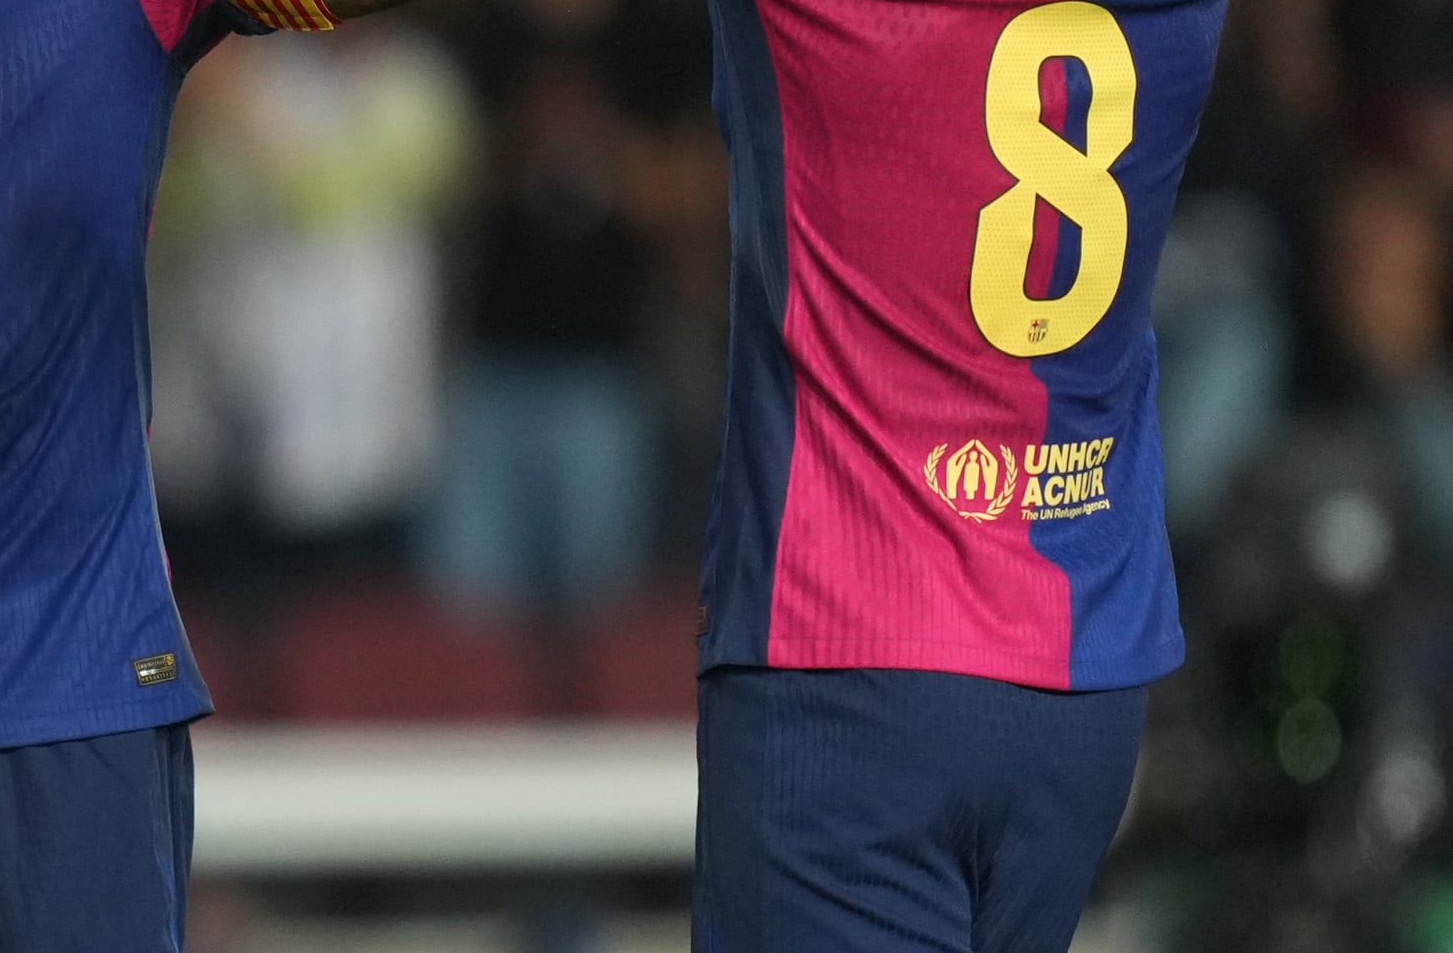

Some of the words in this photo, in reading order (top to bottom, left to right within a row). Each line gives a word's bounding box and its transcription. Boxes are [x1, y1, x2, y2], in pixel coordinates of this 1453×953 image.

[969, 0, 1138, 358] 8
[1023, 436, 1115, 476] UNHCR
[1020, 466, 1105, 508] ACNUR
[1021, 509, 1039, 521] The
[1040, 508, 1054, 520] UN
